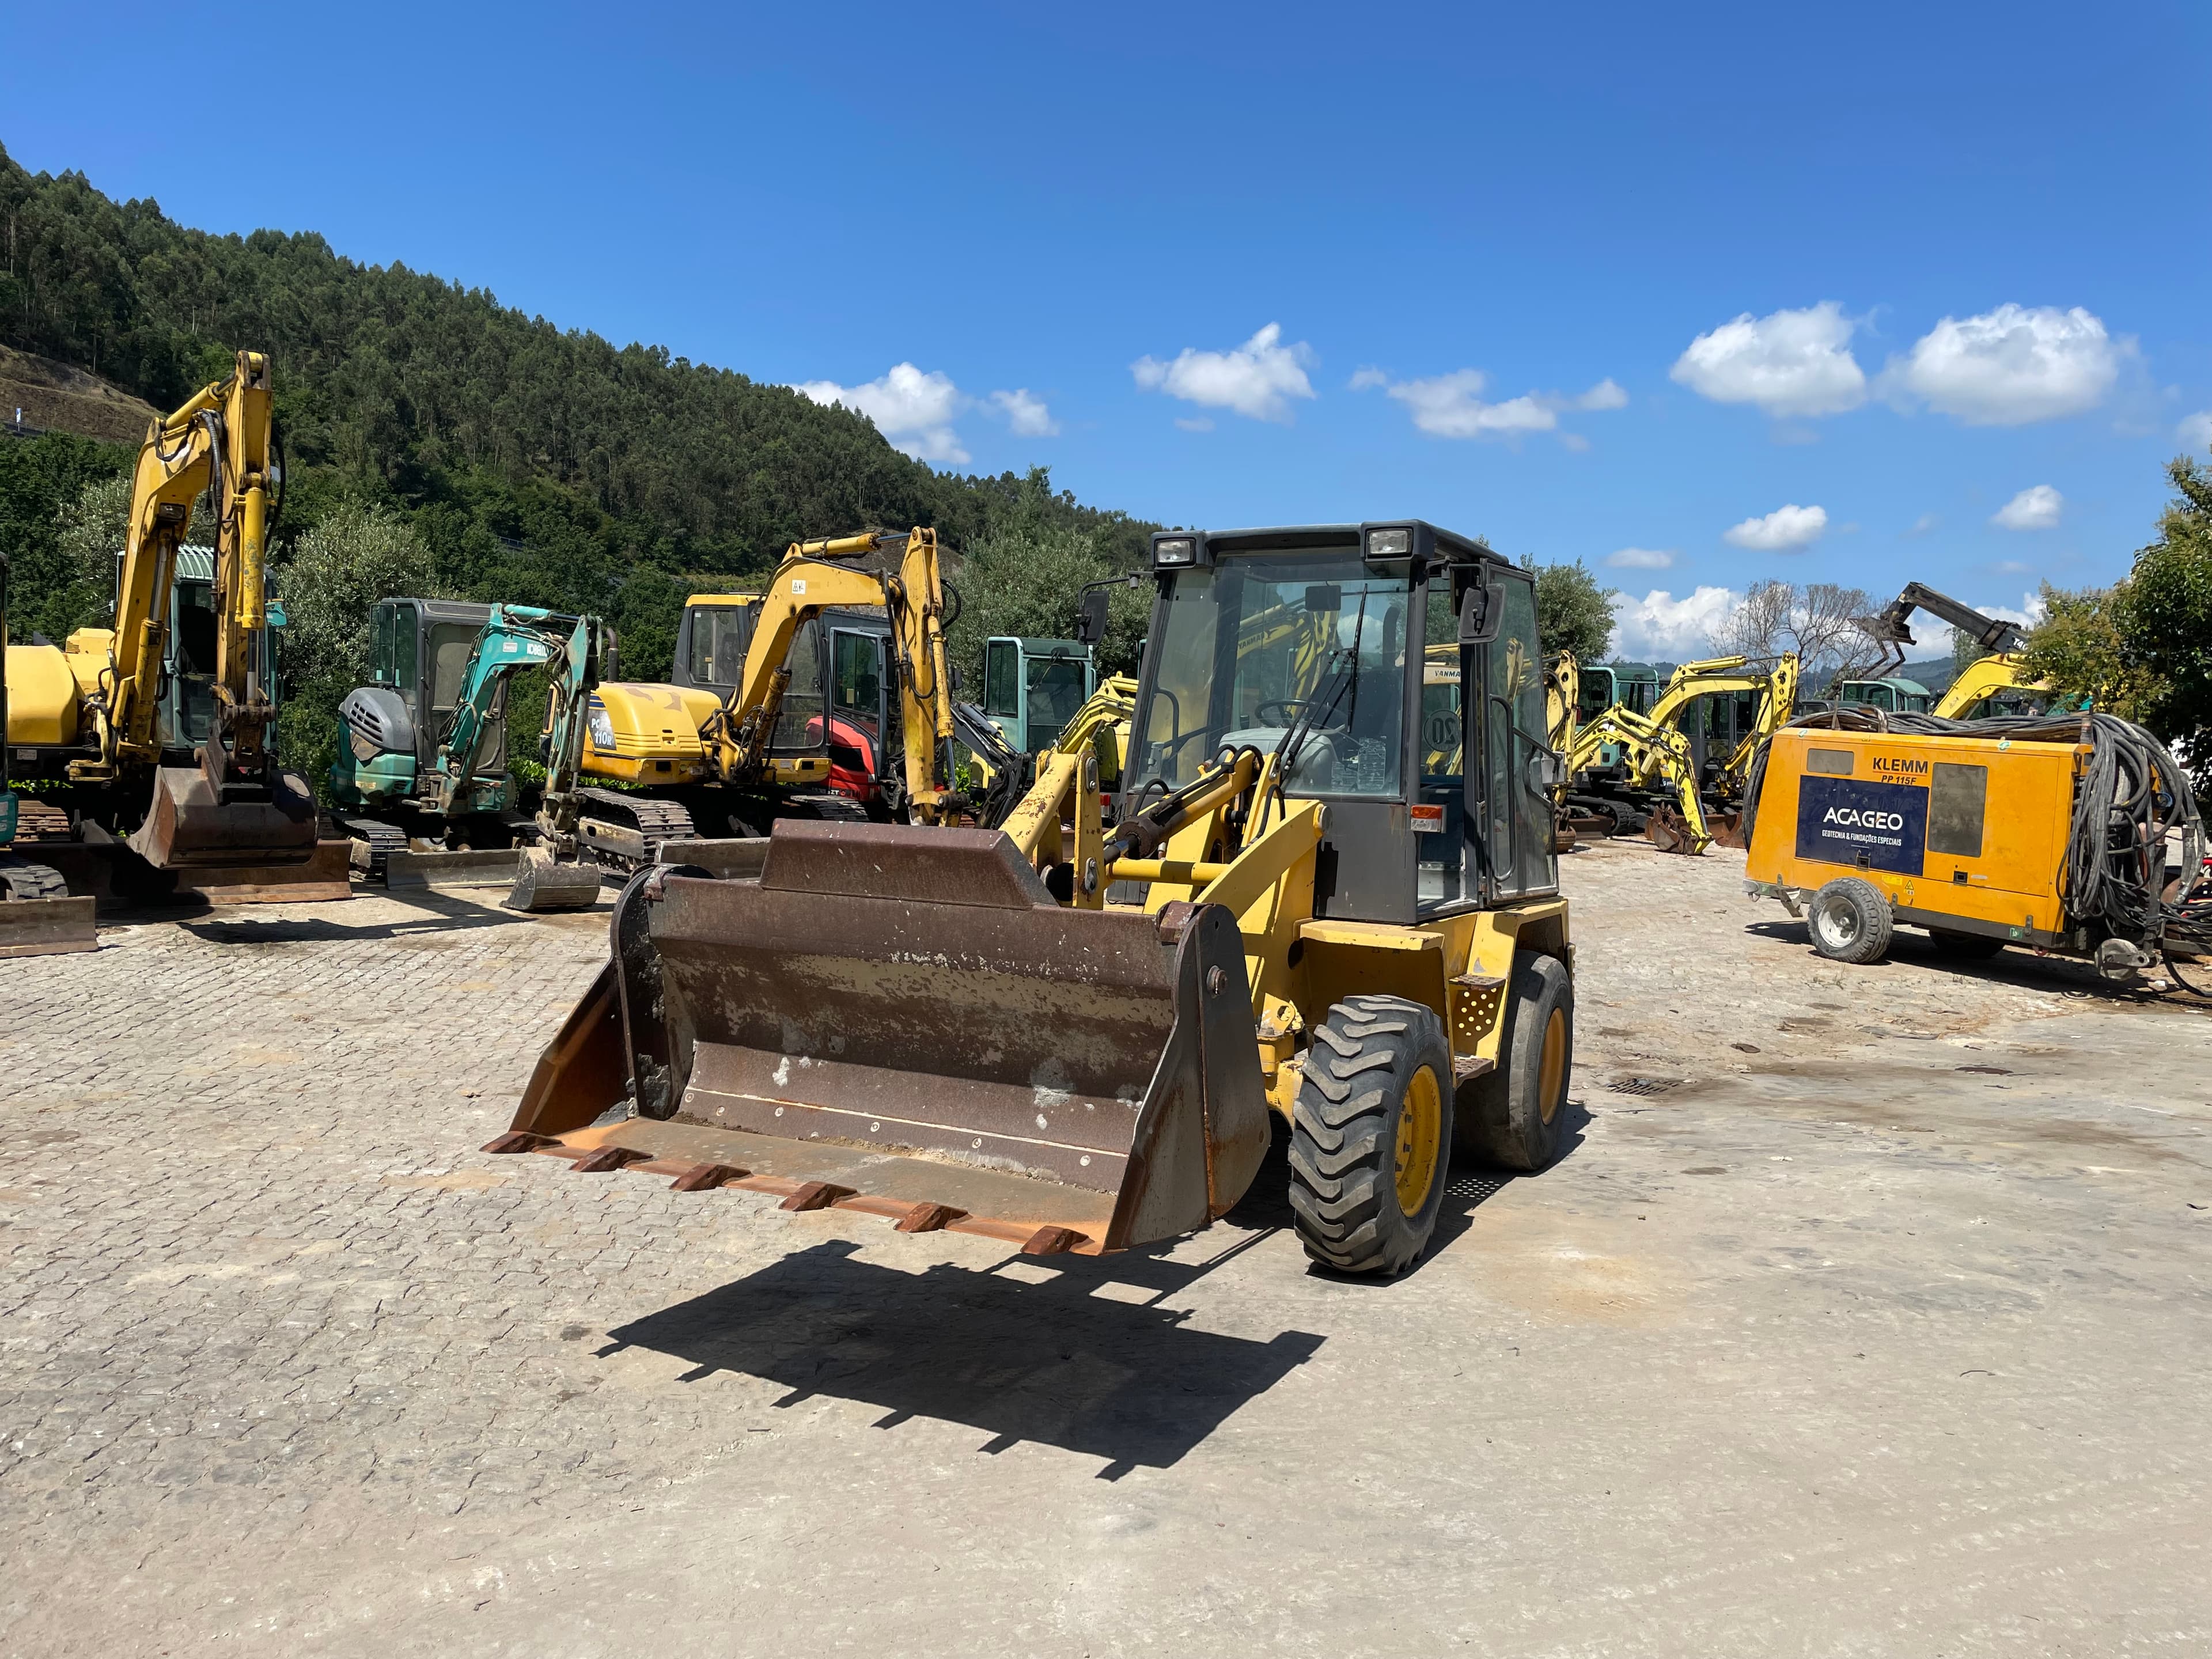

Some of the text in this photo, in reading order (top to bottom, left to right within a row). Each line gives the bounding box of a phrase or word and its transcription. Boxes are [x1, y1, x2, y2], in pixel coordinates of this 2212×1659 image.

[1873, 757, 1928, 773] KLEMM
[1881, 775, 1893, 783] PP
[1823, 806, 1903, 830] ACAGEO
[1822, 830, 1846, 839] GEOTECNIA
[1851, 833, 1877, 844] FUNDAÇÕES
[1878, 836, 1902, 846] ESPECIAIS
